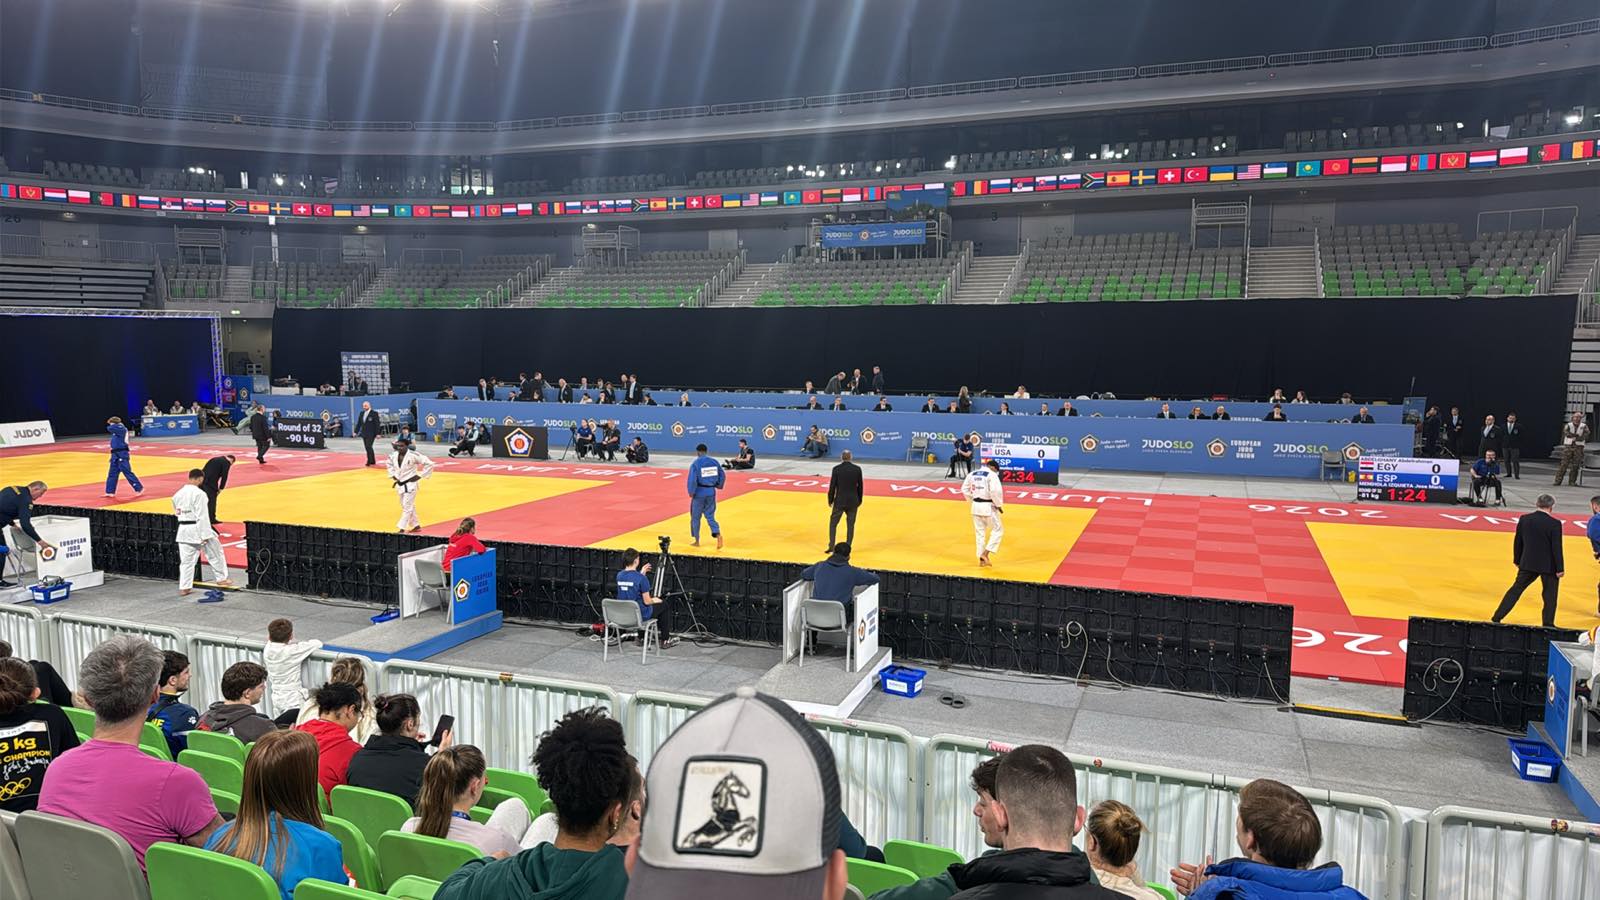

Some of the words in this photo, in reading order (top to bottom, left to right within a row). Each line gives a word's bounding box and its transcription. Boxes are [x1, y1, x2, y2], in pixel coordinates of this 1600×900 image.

[278, 423, 301, 432] Round
[302, 424, 310, 432] of
[311, 424, 321, 433] 32
[543, 419, 577, 427] JUDOSLO
[627, 422, 663, 430] JUDOSLO
[13, 429, 41, 438] JUDO
[715, 425, 753, 433] JUDOSLO
[286, 434, 302, 443] -90
[303, 434, 315, 445] kg
[1021, 435, 1068, 445] JUDOSLO
[1141, 439, 1194, 449] JUDOSLO
[994, 448, 1011, 456] USA
[1037, 449, 1045, 458] 0
[1273, 443, 1328, 454] JUDOSLO
[994, 458, 1012, 466] ESP
[1037, 459, 1044, 469] 1
[1377, 463, 1398, 471] EGY
[1432, 464, 1441, 474] 0
[1002, 470, 1035, 483] 2:34
[1376, 474, 1398, 482] ESP
[1431, 475, 1440, 485] 0
[1387, 488, 1427, 502] 1:24
[1248, 504, 1388, 519] 2026
[59, 537, 87, 547] EUROPEAN
[67, 544, 81, 552] JUDO
[65, 550, 82, 558] UNION
[13, 737, 37, 750] kg
[3, 750, 51, 763] CHAMPION
